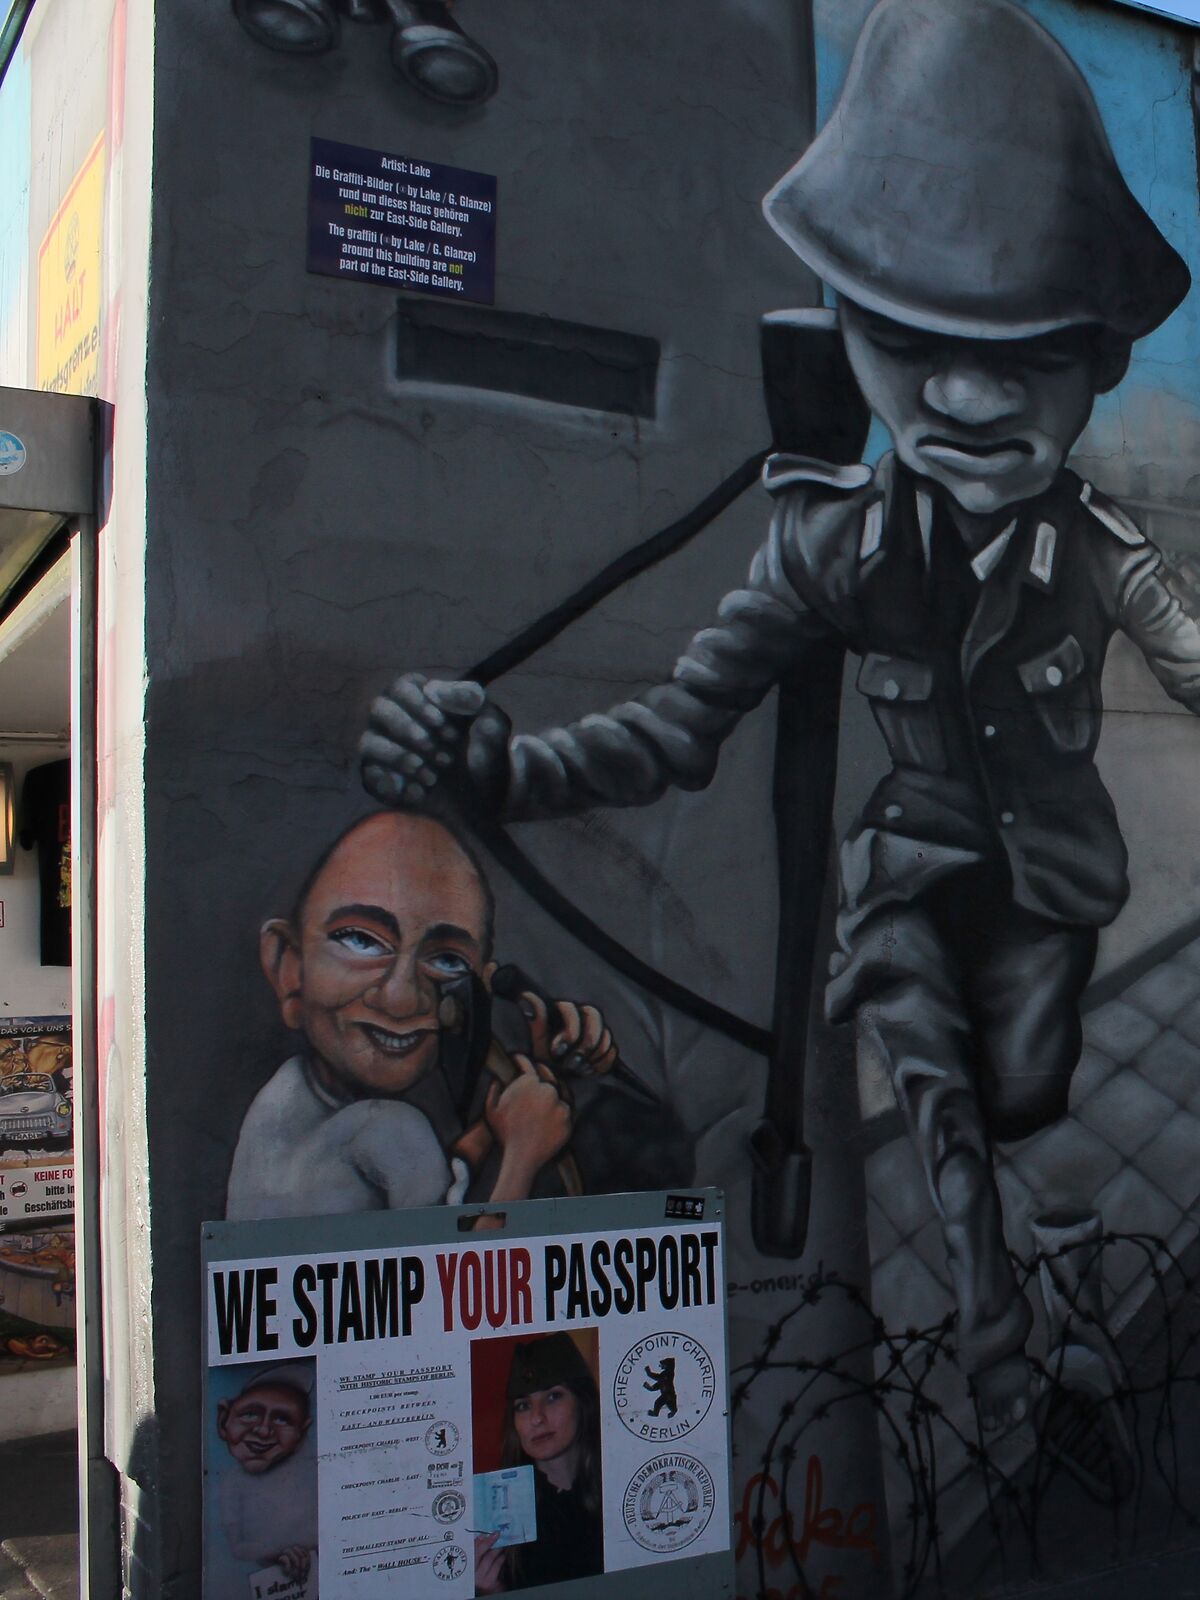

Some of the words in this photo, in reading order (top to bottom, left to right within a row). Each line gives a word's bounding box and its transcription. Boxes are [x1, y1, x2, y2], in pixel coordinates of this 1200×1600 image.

[381, 157, 408, 173] Artist:
[410, 164, 431, 178] Lake
[315, 165, 330, 179] Die
[333, 169, 393, 192] Graffiti-Bilder
[408, 185, 418, 197] by
[420, 187, 440, 201] Lake
[448, 194, 457, 205] G.
[459, 196, 491, 213] Glanze)
[339, 187, 360, 201] rund
[362, 192, 376, 204] um
[379, 195, 408, 210] dieses
[410, 201, 431, 215] Haus
[433, 206, 469, 223] gehören
[344, 204, 368, 218] nicht
[370, 210, 385, 221] zur
[387, 211, 428, 230] East-Side
[430, 221, 463, 238] Gallery.
[328, 223, 345, 237] The
[347, 229, 377, 244] graffiti
[391, 236, 401, 249] by
[404, 238, 425, 252] Lake
[433, 244, 442, 256] G.
[444, 247, 476, 263] Glanze)
[342, 243, 374, 257] around
[376, 249, 397, 262] this
[395, 252, 430, 270] building
[433, 262, 447, 272] are
[449, 263, 463, 275] not
[340, 259, 360, 272] part
[360, 262, 369, 273] of
[371, 263, 386, 276] the
[388, 266, 430, 284] East-Side
[432, 275, 464, 291] Gallery.
[55, 268, 86, 350] HALT
[35, 1170, 60, 1181] KEINE
[63, 1169, 74, 1179] FO
[46, 1186, 64, 1196] bitte
[214, 1266, 278, 1355] WE
[292, 1256, 425, 1347] STAMP
[436, 1247, 532, 1332] YOUR
[544, 1232, 719, 1322] PASSPORT
[353, 1373, 376, 1381] STAMP
[381, 1370, 405, 1378] YOUR
[410, 1365, 453, 1374] PASSPORT
[361, 1379, 392, 1388] HISTORIC
[394, 1376, 420, 1384] STAMPS
[617, 1336, 679, 1408] CHECKPOINT
[682, 1340, 712, 1399] CHARLIE
[400, 1400, 437, 1409] BETWEEN
[640, 1419, 690, 1439] BERLIN
[341, 1443, 374, 1451] CHECKPOINT
[341, 1481, 375, 1489] CHECKPOINT
[637, 1456, 699, 1482] DEMOKRATISCHE
[696, 1468, 712, 1508] REPUBLIK
[342, 1513, 361, 1521] POLICE
[256, 1587, 261, 1599] I
